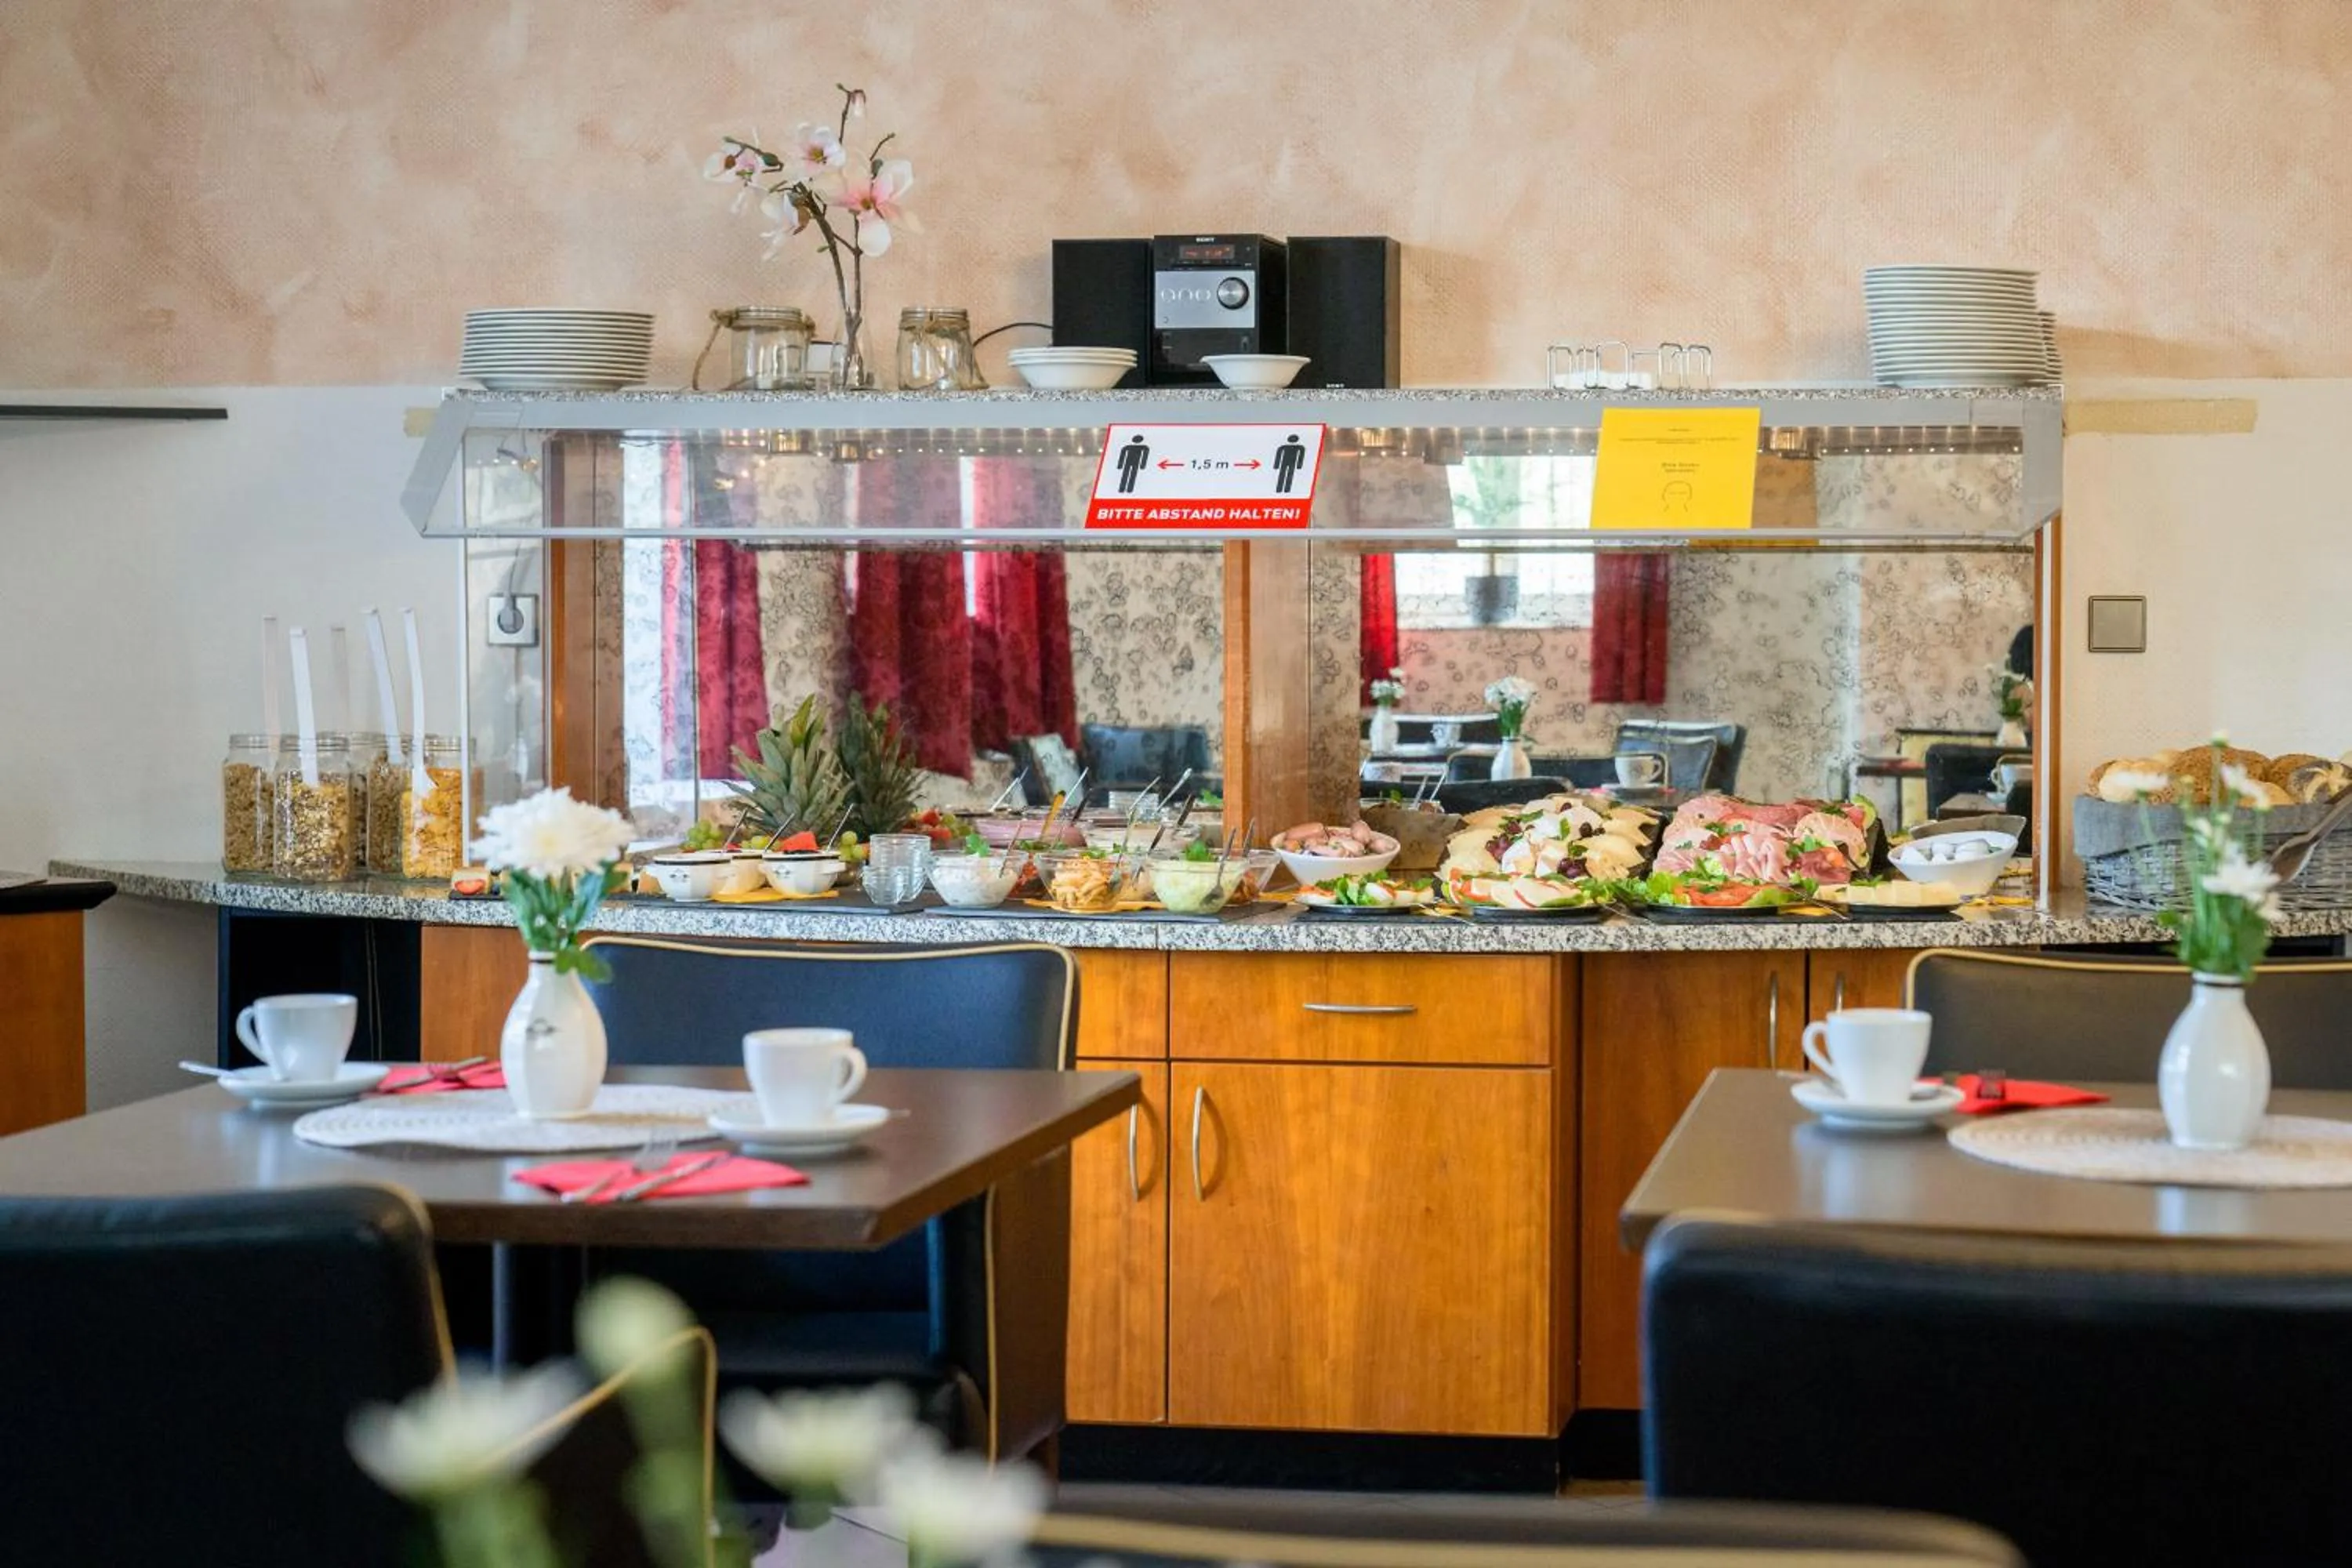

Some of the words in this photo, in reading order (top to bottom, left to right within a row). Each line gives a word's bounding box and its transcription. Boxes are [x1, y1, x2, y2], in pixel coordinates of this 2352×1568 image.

[1191, 460, 1211, 470] 1,5
[1097, 508, 1142, 520] BITTE
[1148, 508, 1225, 520] ABSTAND
[1229, 508, 1301, 520] HALTEN!
